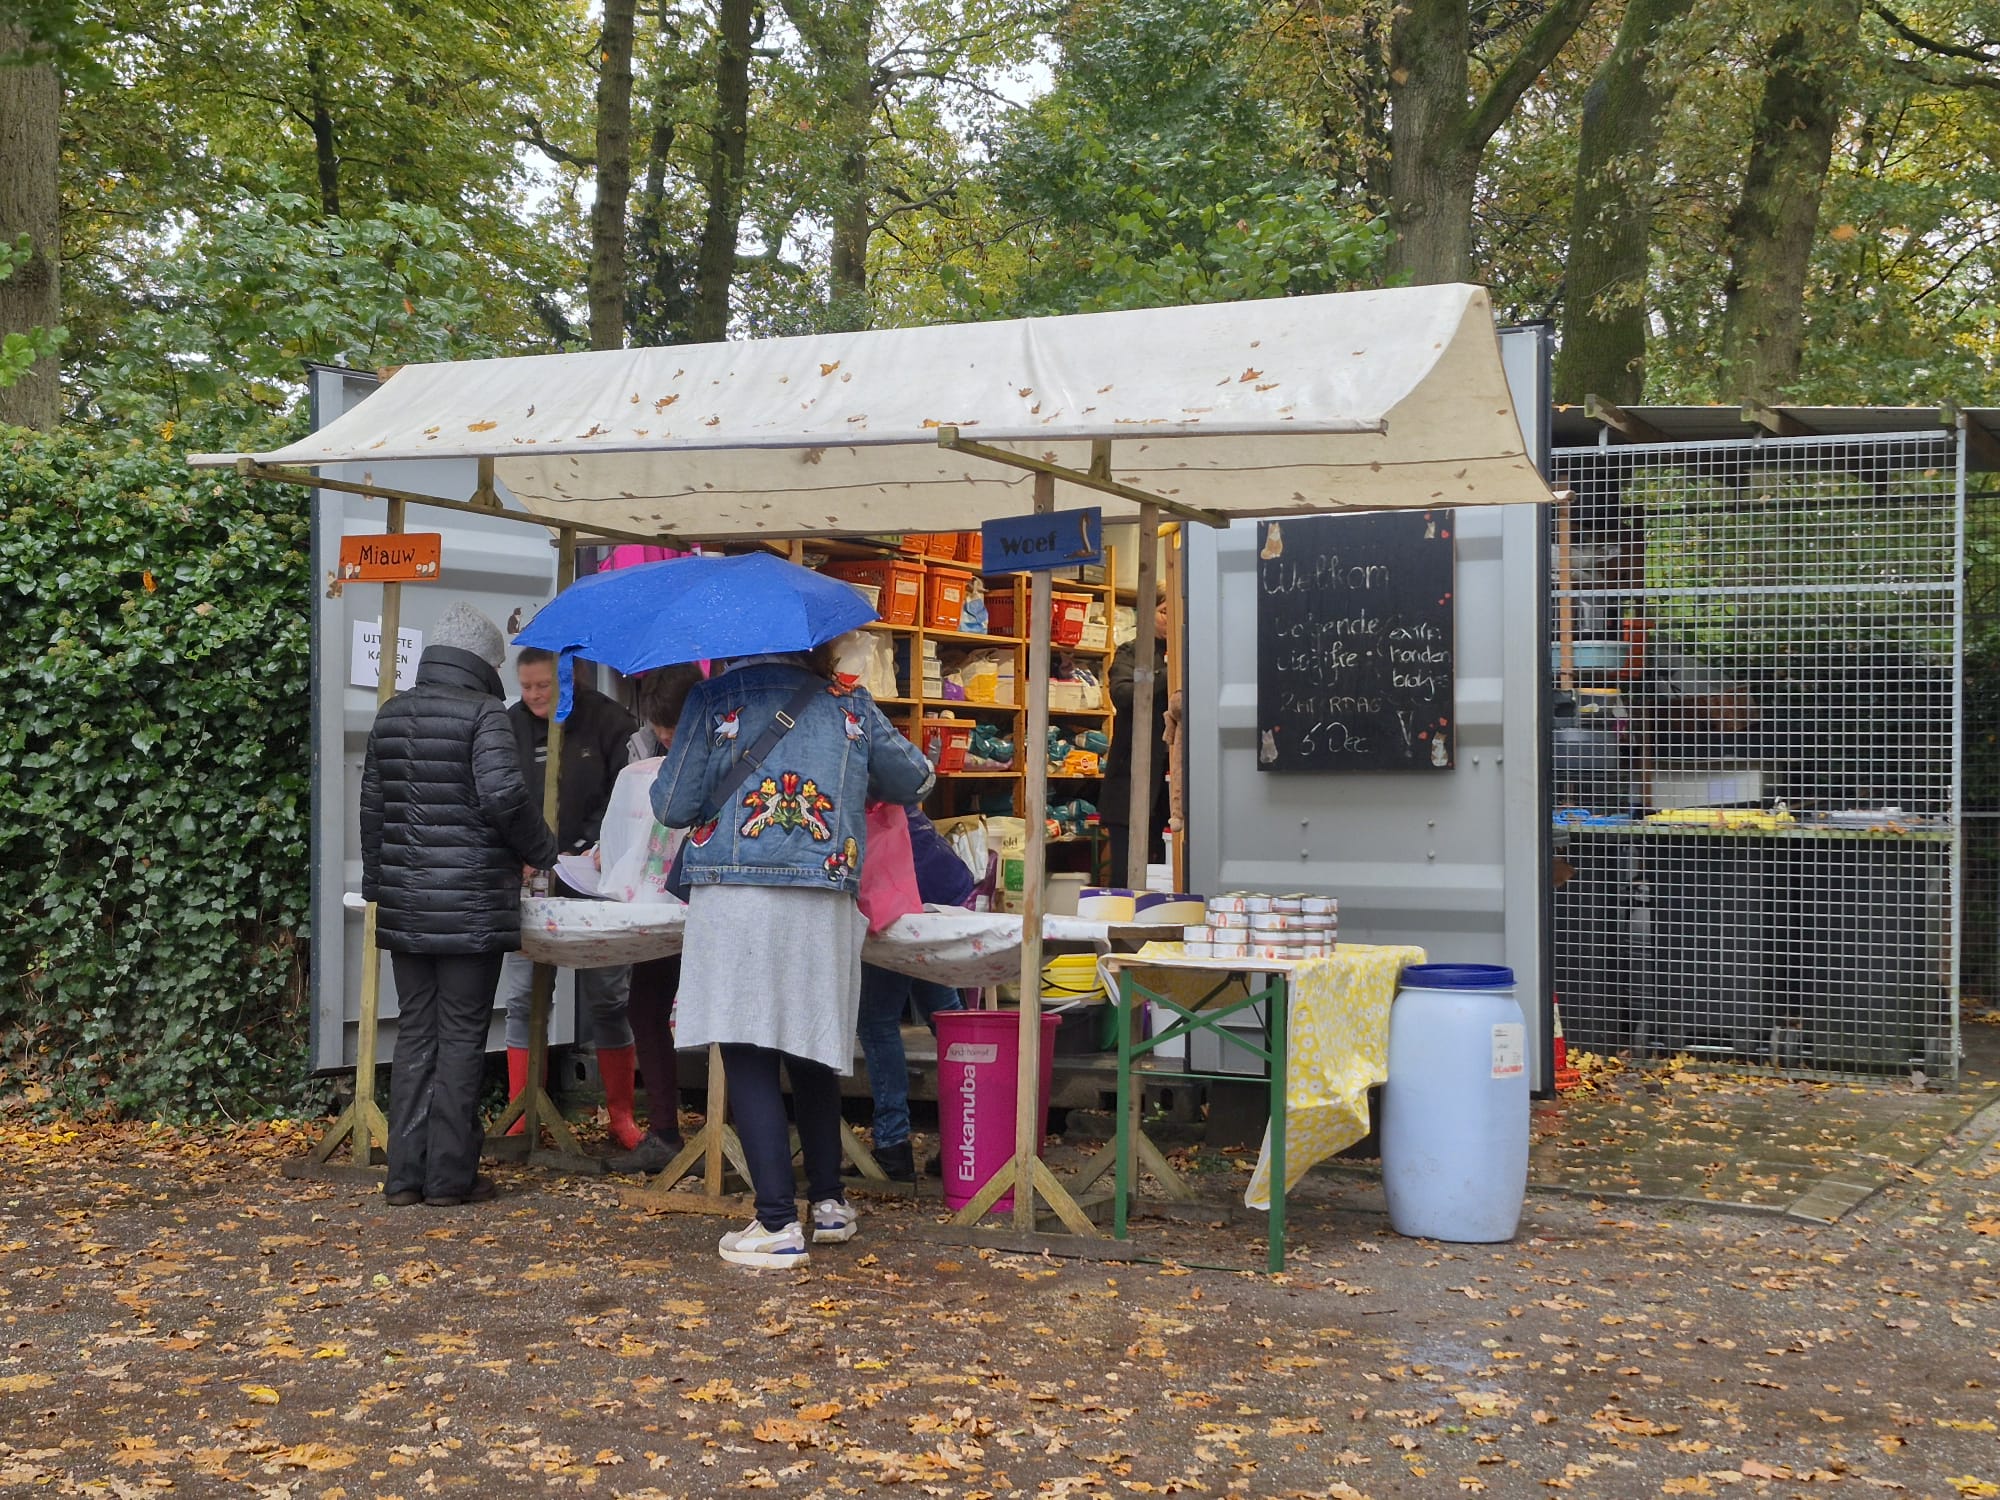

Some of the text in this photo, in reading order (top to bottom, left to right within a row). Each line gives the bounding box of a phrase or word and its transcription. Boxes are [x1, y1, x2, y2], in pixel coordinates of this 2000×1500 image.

[358, 544, 416, 566] Miauw
[1000, 530, 1057, 557] Woef
[958, 1064, 976, 1182] Eukanuba
